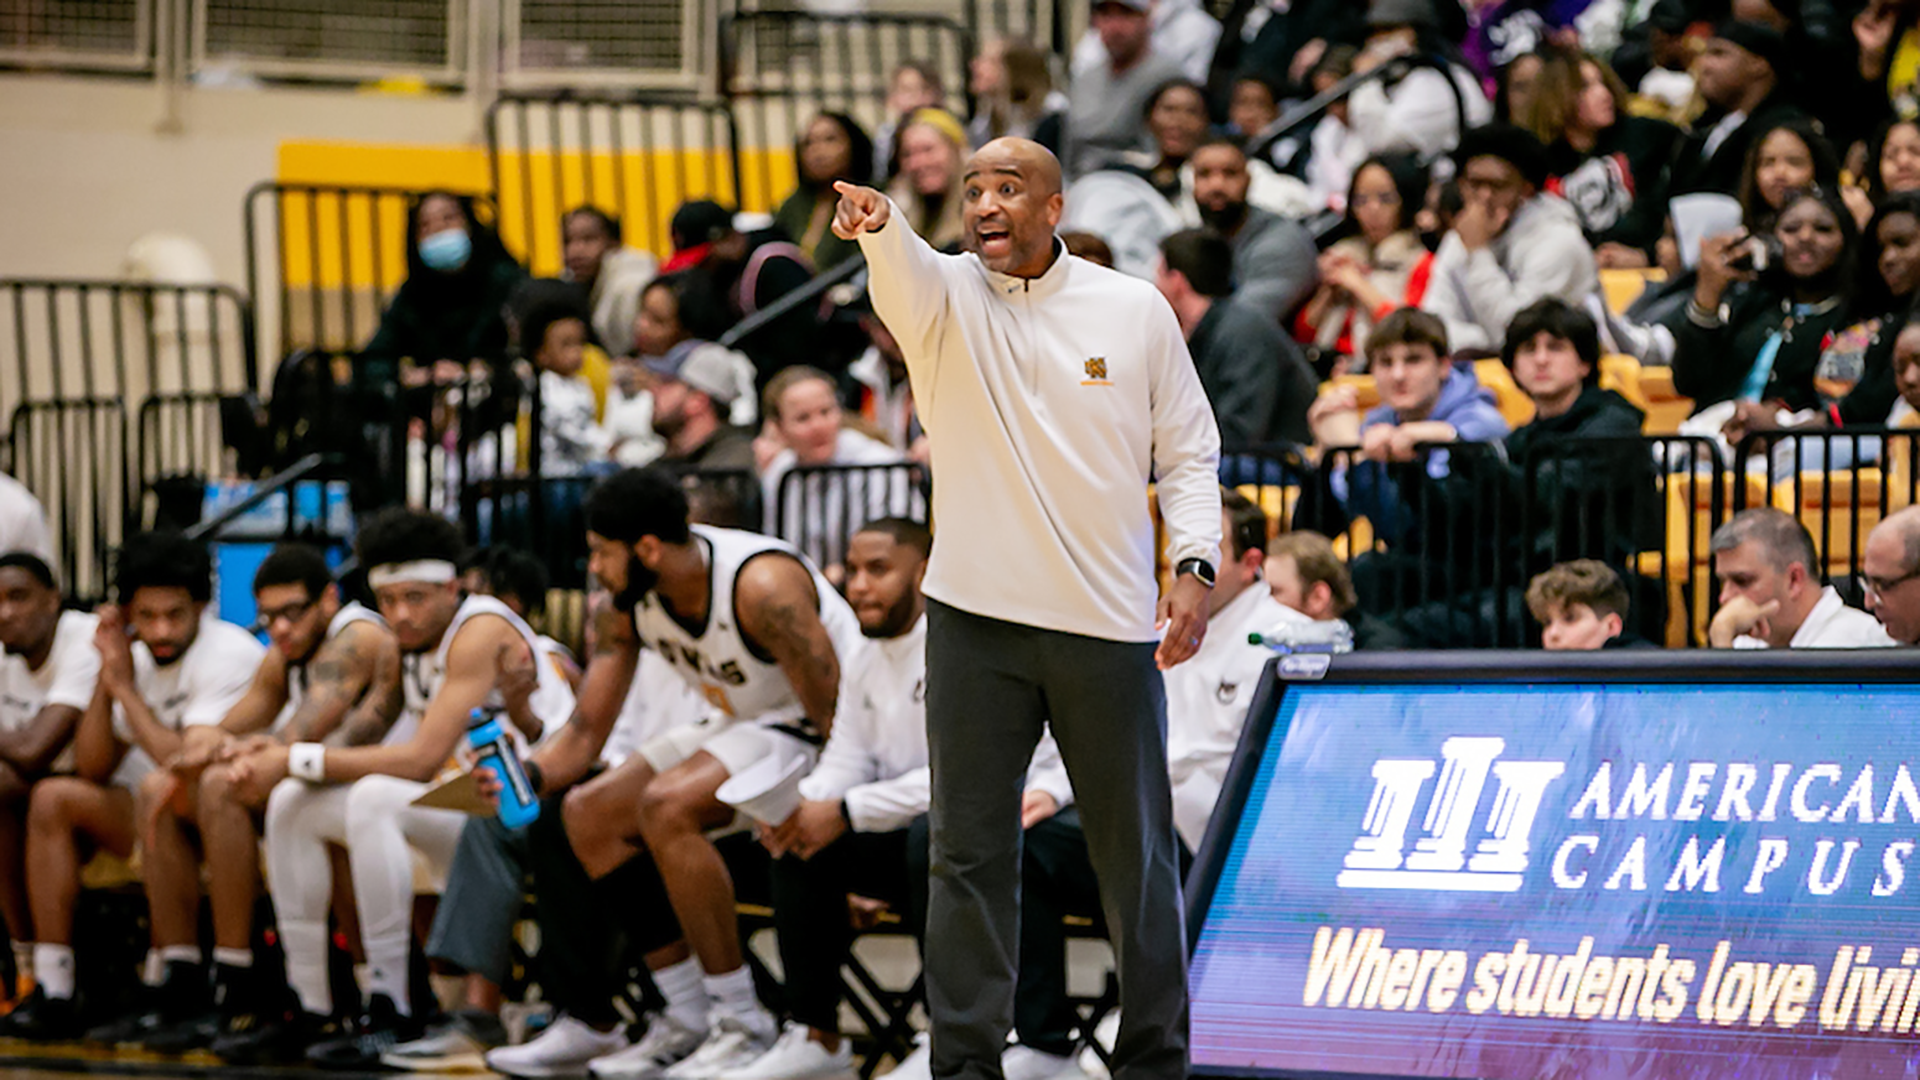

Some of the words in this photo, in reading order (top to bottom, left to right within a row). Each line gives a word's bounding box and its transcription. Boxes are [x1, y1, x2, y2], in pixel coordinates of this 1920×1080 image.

[1568, 761, 1920, 823] AMERICAN
[1550, 834, 1916, 897] CAMPUS
[1303, 926, 1468, 1014] Where
[1465, 935, 1697, 1023] students
[1696, 940, 1817, 1028] love
[1819, 945, 1920, 1033] livi
